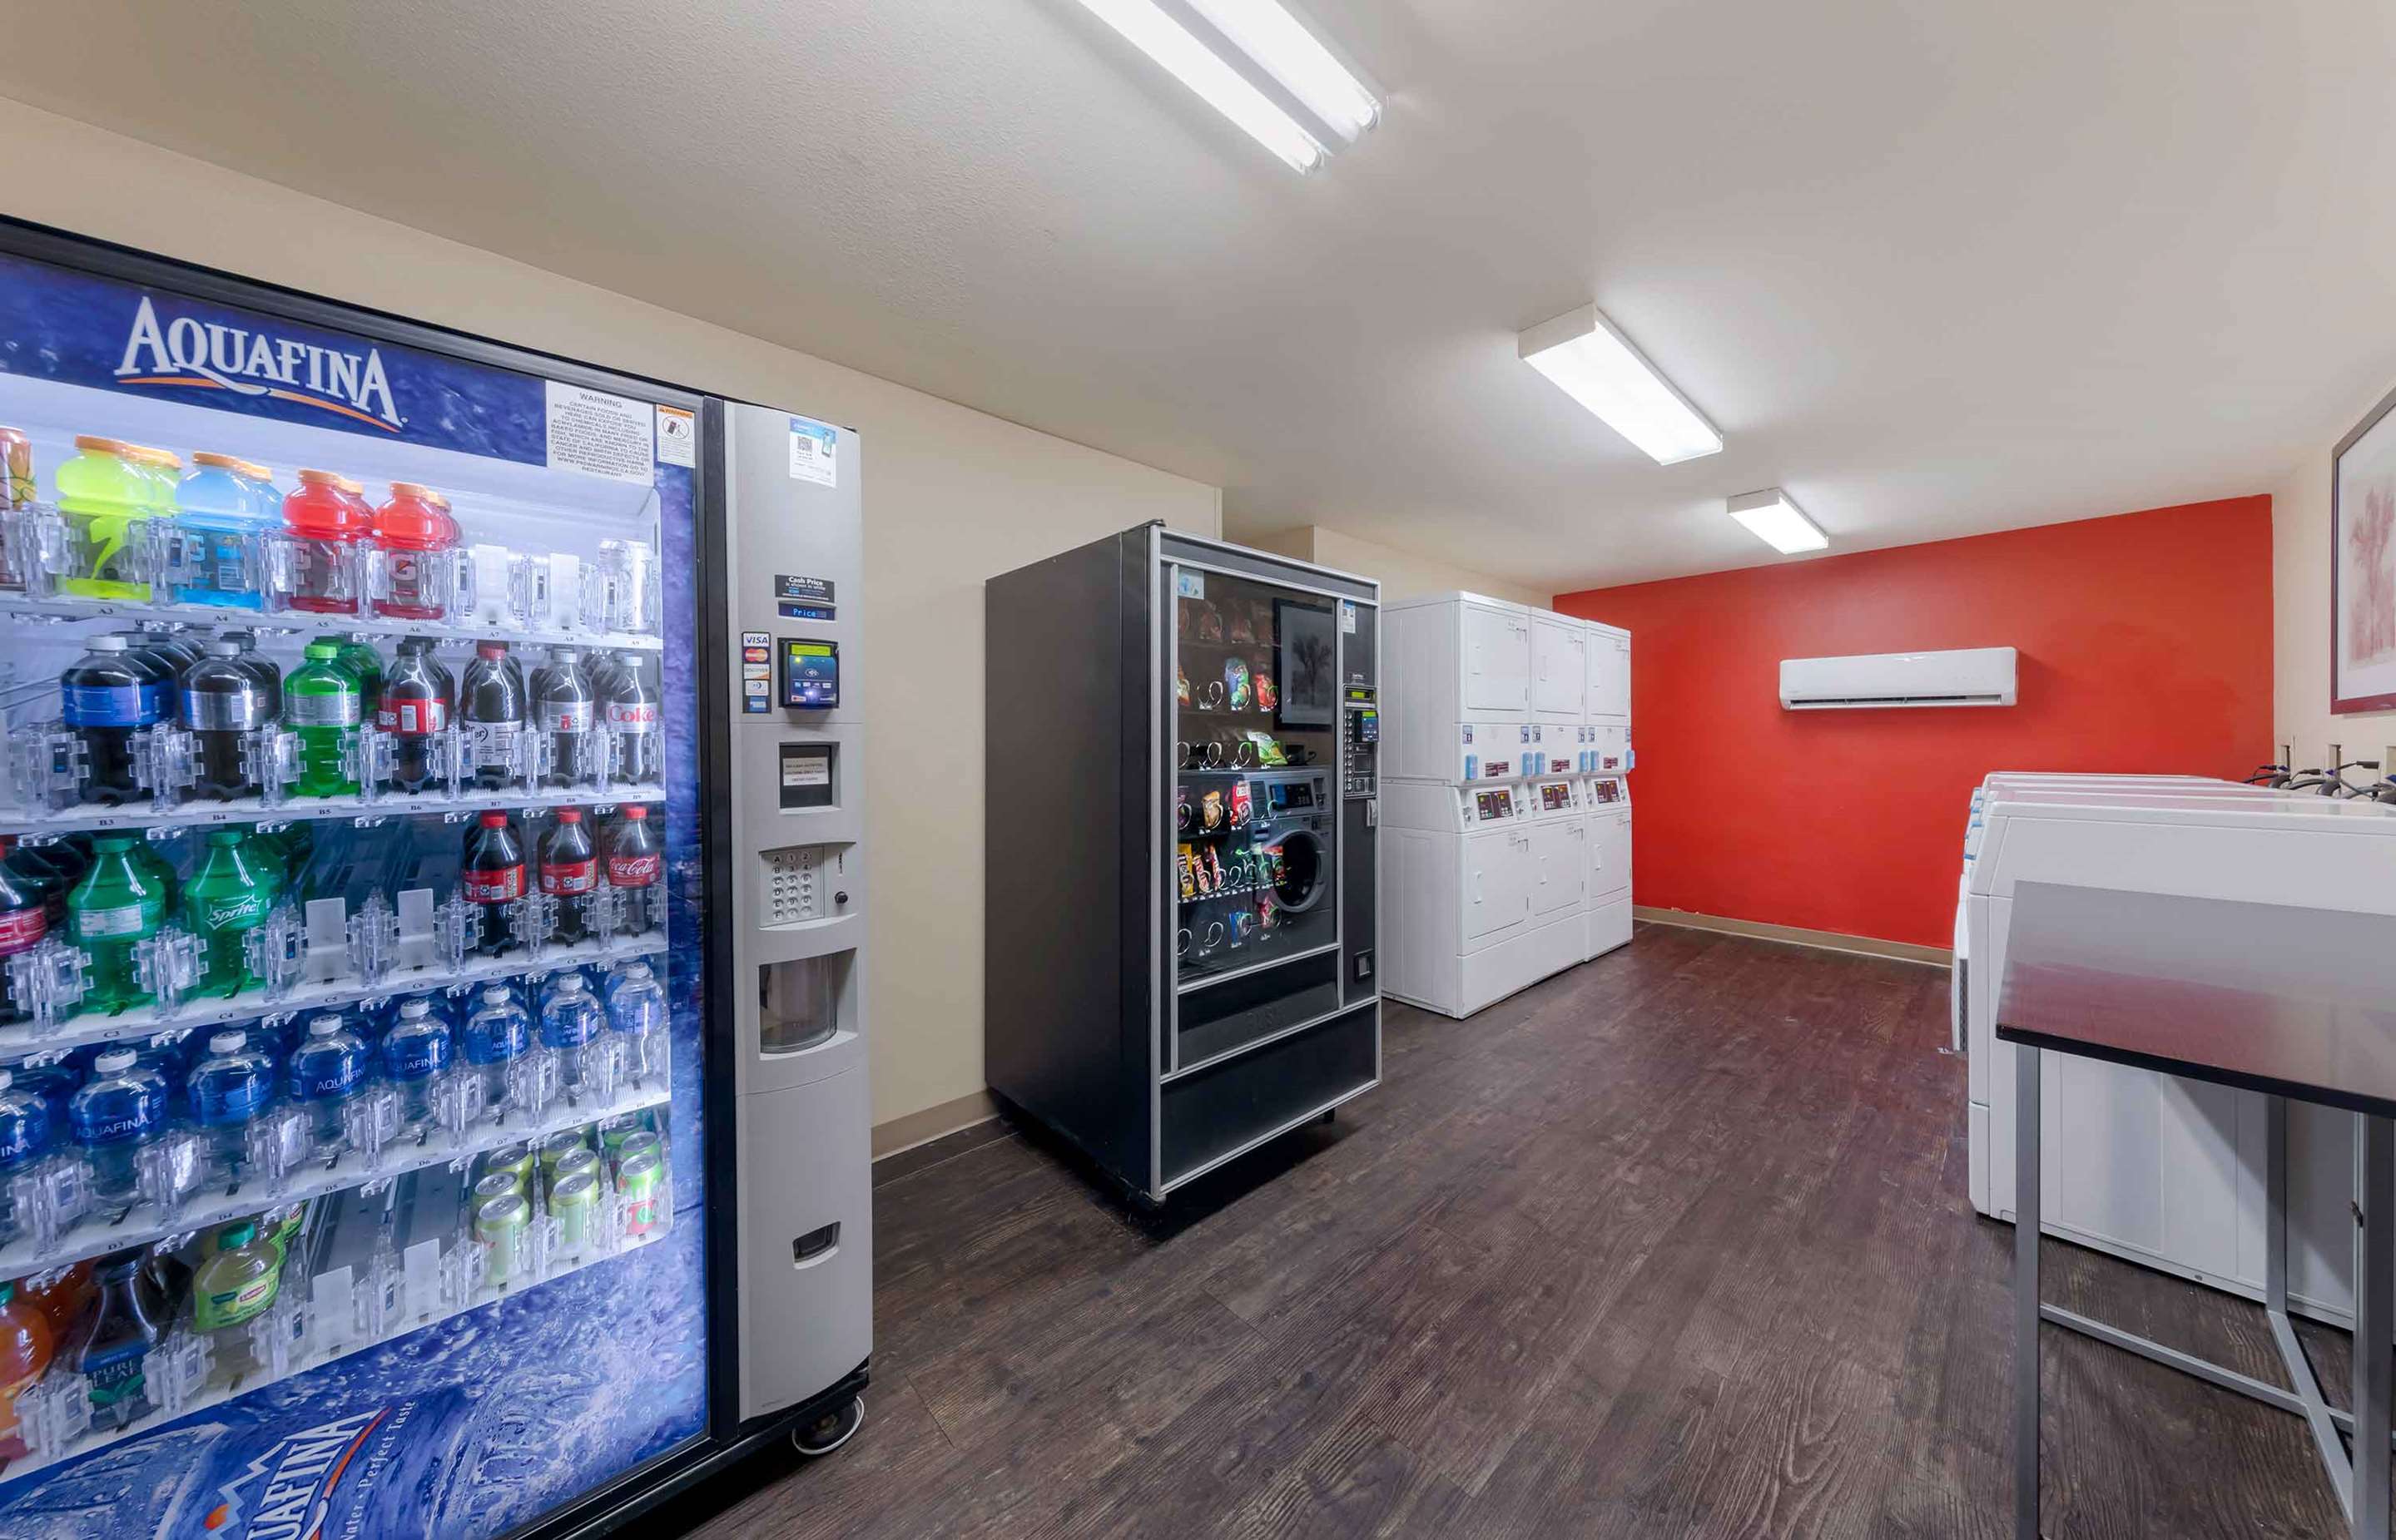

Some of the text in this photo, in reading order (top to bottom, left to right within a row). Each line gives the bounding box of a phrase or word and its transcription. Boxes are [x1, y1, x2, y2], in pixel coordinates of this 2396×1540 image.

[114, 296, 403, 428] AQUAFINA
[579, 392, 622, 408] WARNING
[793, 608, 816, 617] Price
[610, 706, 653, 722] Coke
[210, 904, 256, 922] Sprite
[76, 1112, 152, 1138] AQUAFINA
[108, 1240, 124, 1250] D3
[219, 1212, 232, 1221] D4
[357, 1436, 395, 1488] Perfect
[386, 1401, 415, 1432] Taste
[246, 1409, 382, 1540] UAFINA
